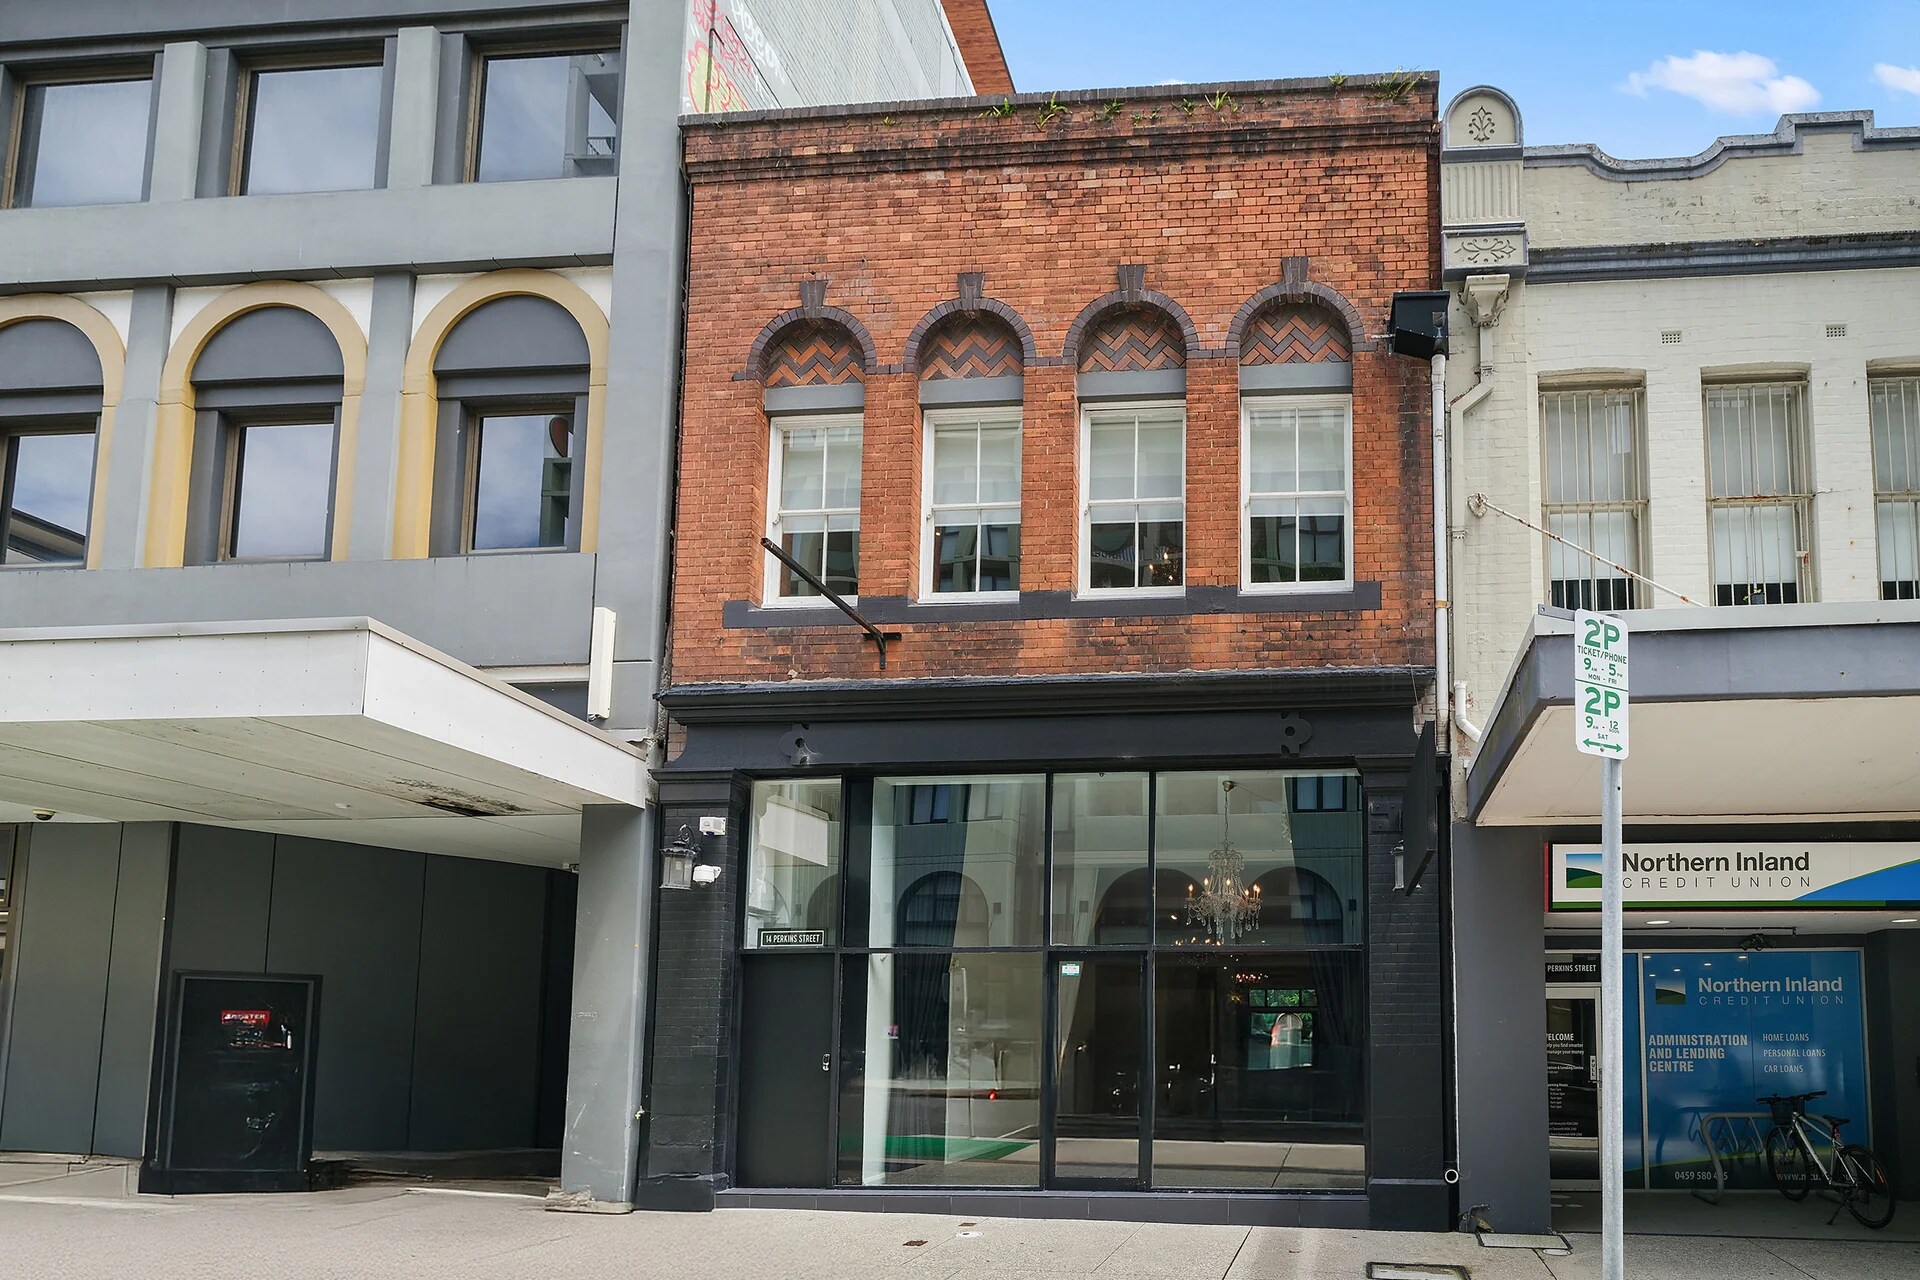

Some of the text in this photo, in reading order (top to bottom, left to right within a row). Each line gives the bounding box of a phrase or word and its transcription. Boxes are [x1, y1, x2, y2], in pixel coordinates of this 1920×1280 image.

[1584, 618, 1620, 650] 2P
[1577, 645, 1627, 664] TICKET/PHONE
[1588, 673, 1601, 681] MON
[1584, 686, 1621, 717] 2P
[1609, 720, 1619, 730] 12
[1622, 851, 1810, 872] Northern Inland
[1622, 876, 1811, 889] CREDIT UNION
[765, 934, 820, 943] 14 PERKINS STREET
[1547, 964, 1597, 972] PERKINS STREET
[1698, 976, 1843, 993] Northern Inland
[1699, 995, 1844, 1006] CREDIT UNION
[1649, 1034, 1748, 1046] ADMINISTRATION
[1762, 1033, 1810, 1042] HOME LOANS
[1649, 1047, 1725, 1059] AND LENDING
[1763, 1048, 1826, 1057] PERSONAL LOANS
[1649, 1060, 1694, 1072] CENTRE
[1764, 1065, 1804, 1073] CAR LOANS
[1674, 1171, 1728, 1180] 0459 580 45
